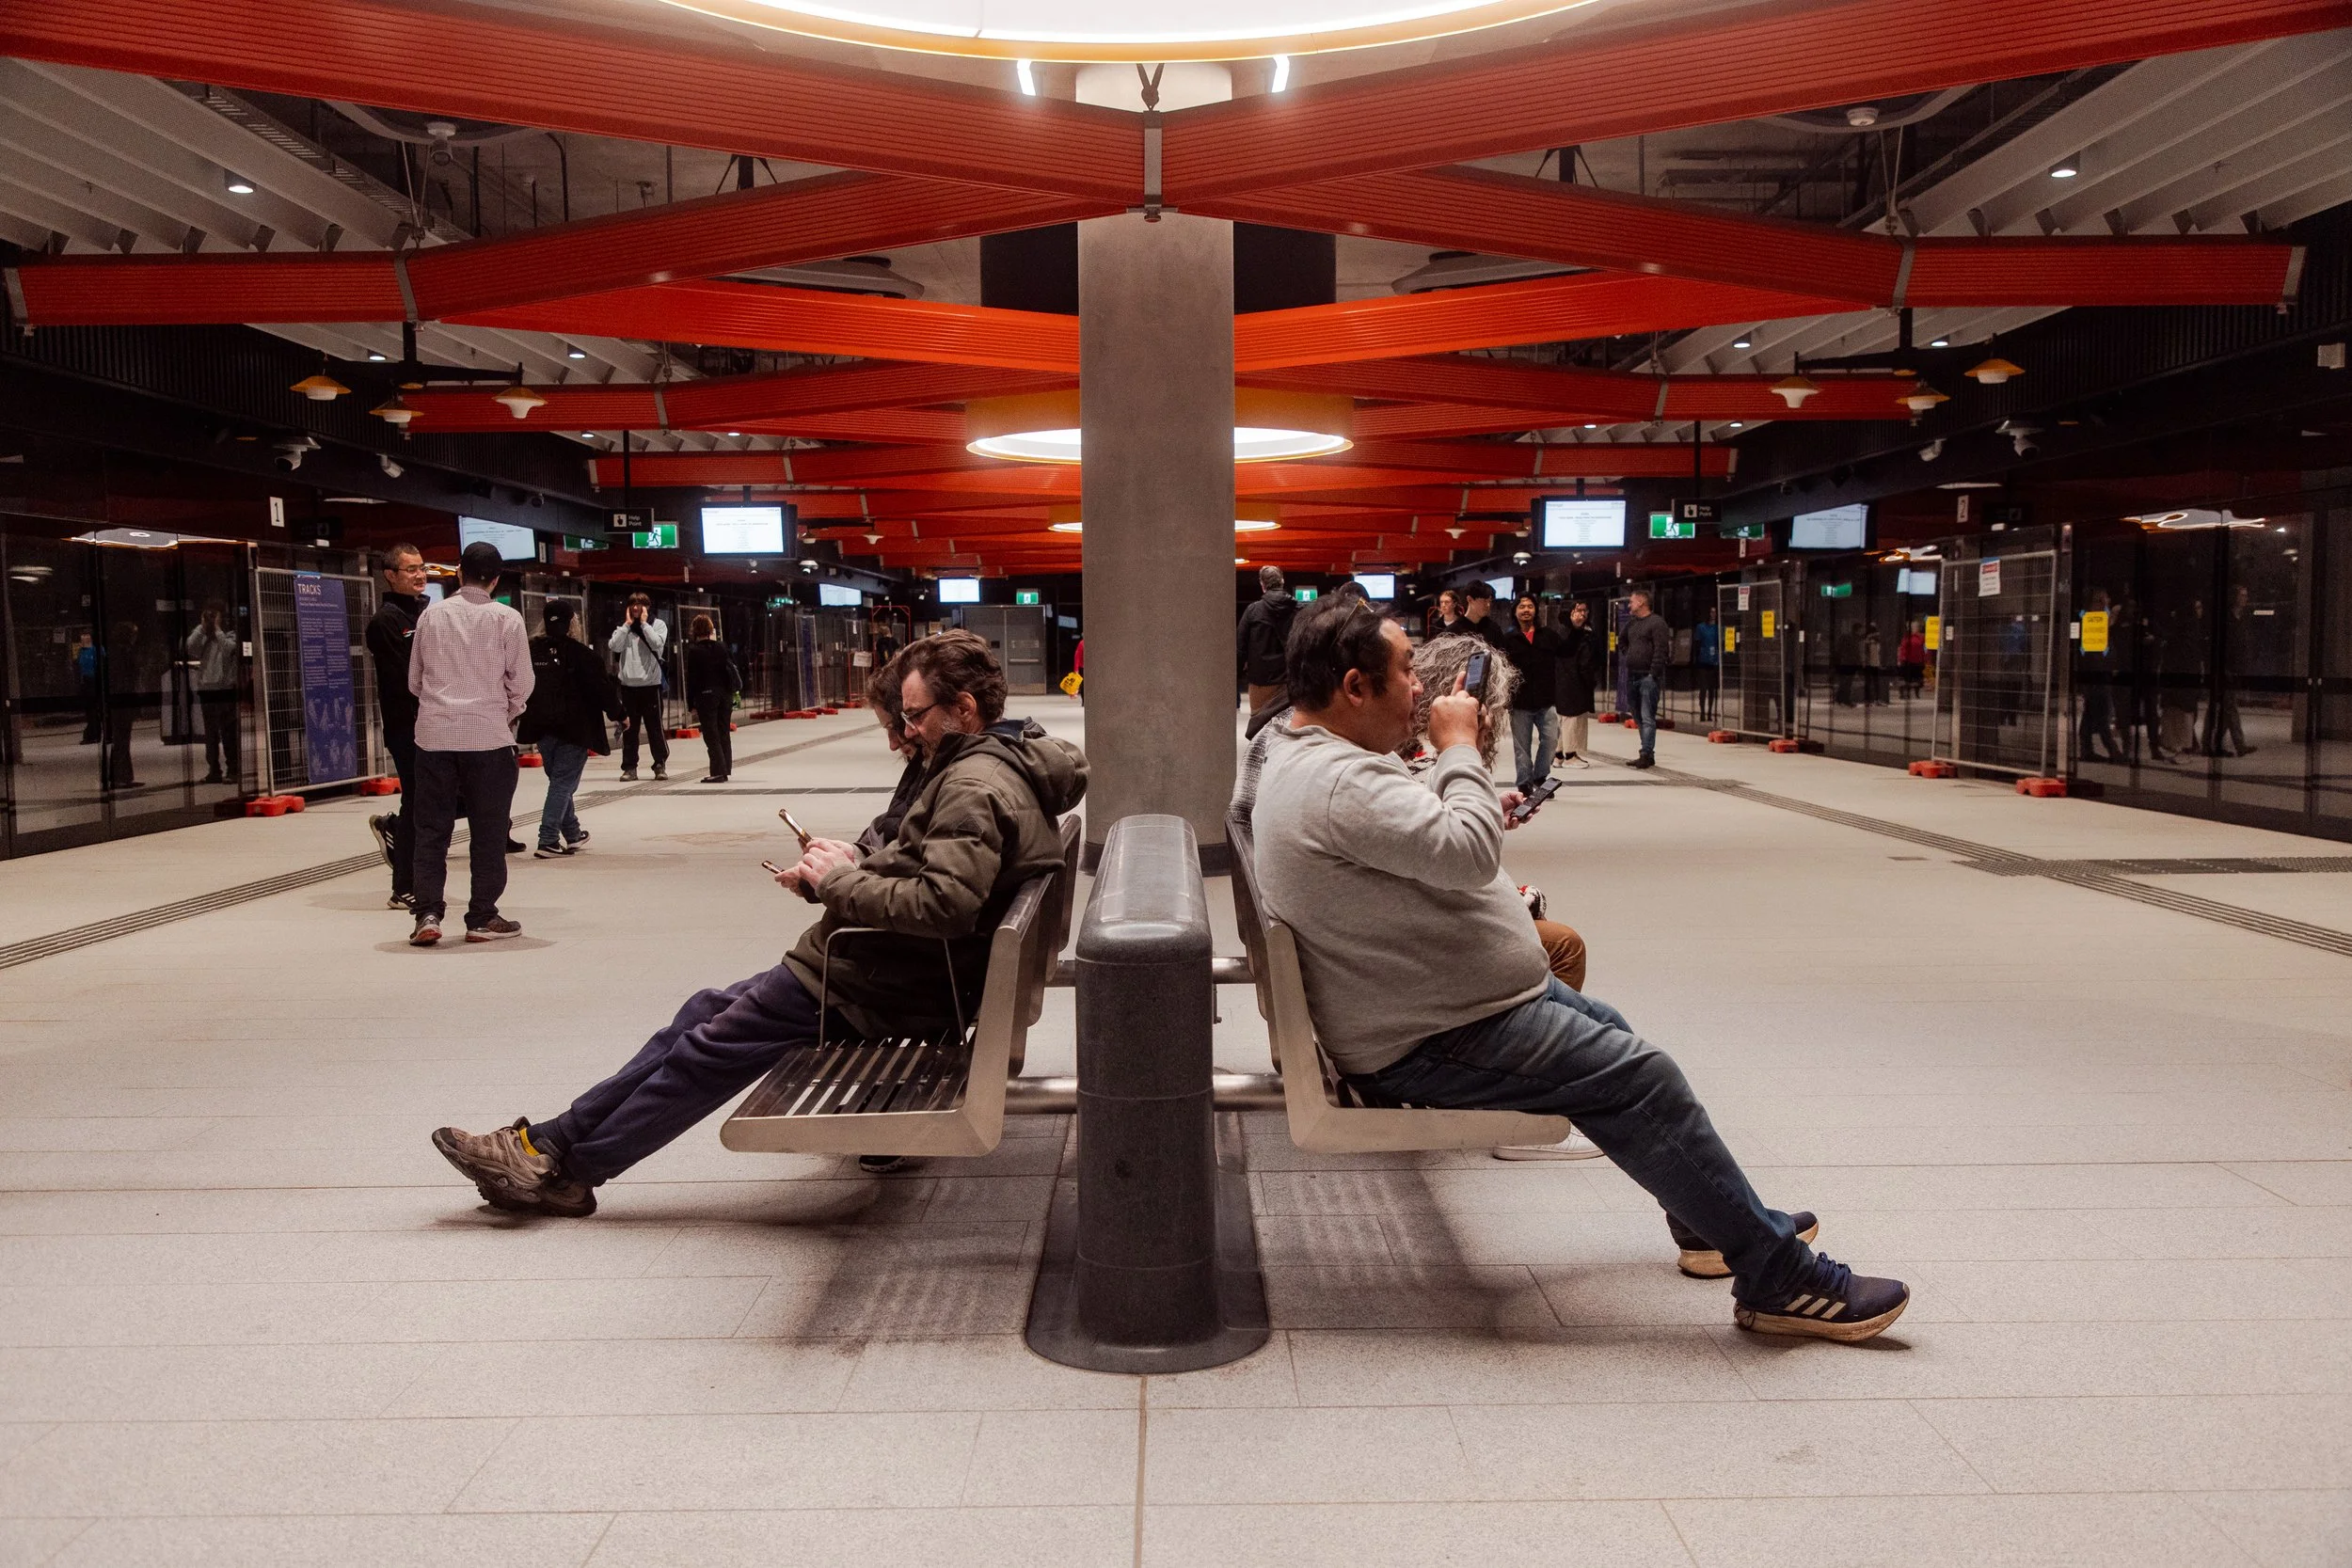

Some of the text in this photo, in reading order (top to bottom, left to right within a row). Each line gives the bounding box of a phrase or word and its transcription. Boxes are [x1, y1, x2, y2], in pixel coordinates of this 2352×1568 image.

[274, 501, 280, 523] 1
[1959, 499, 1966, 519] 2
[297, 583, 322, 595] TRACKS
